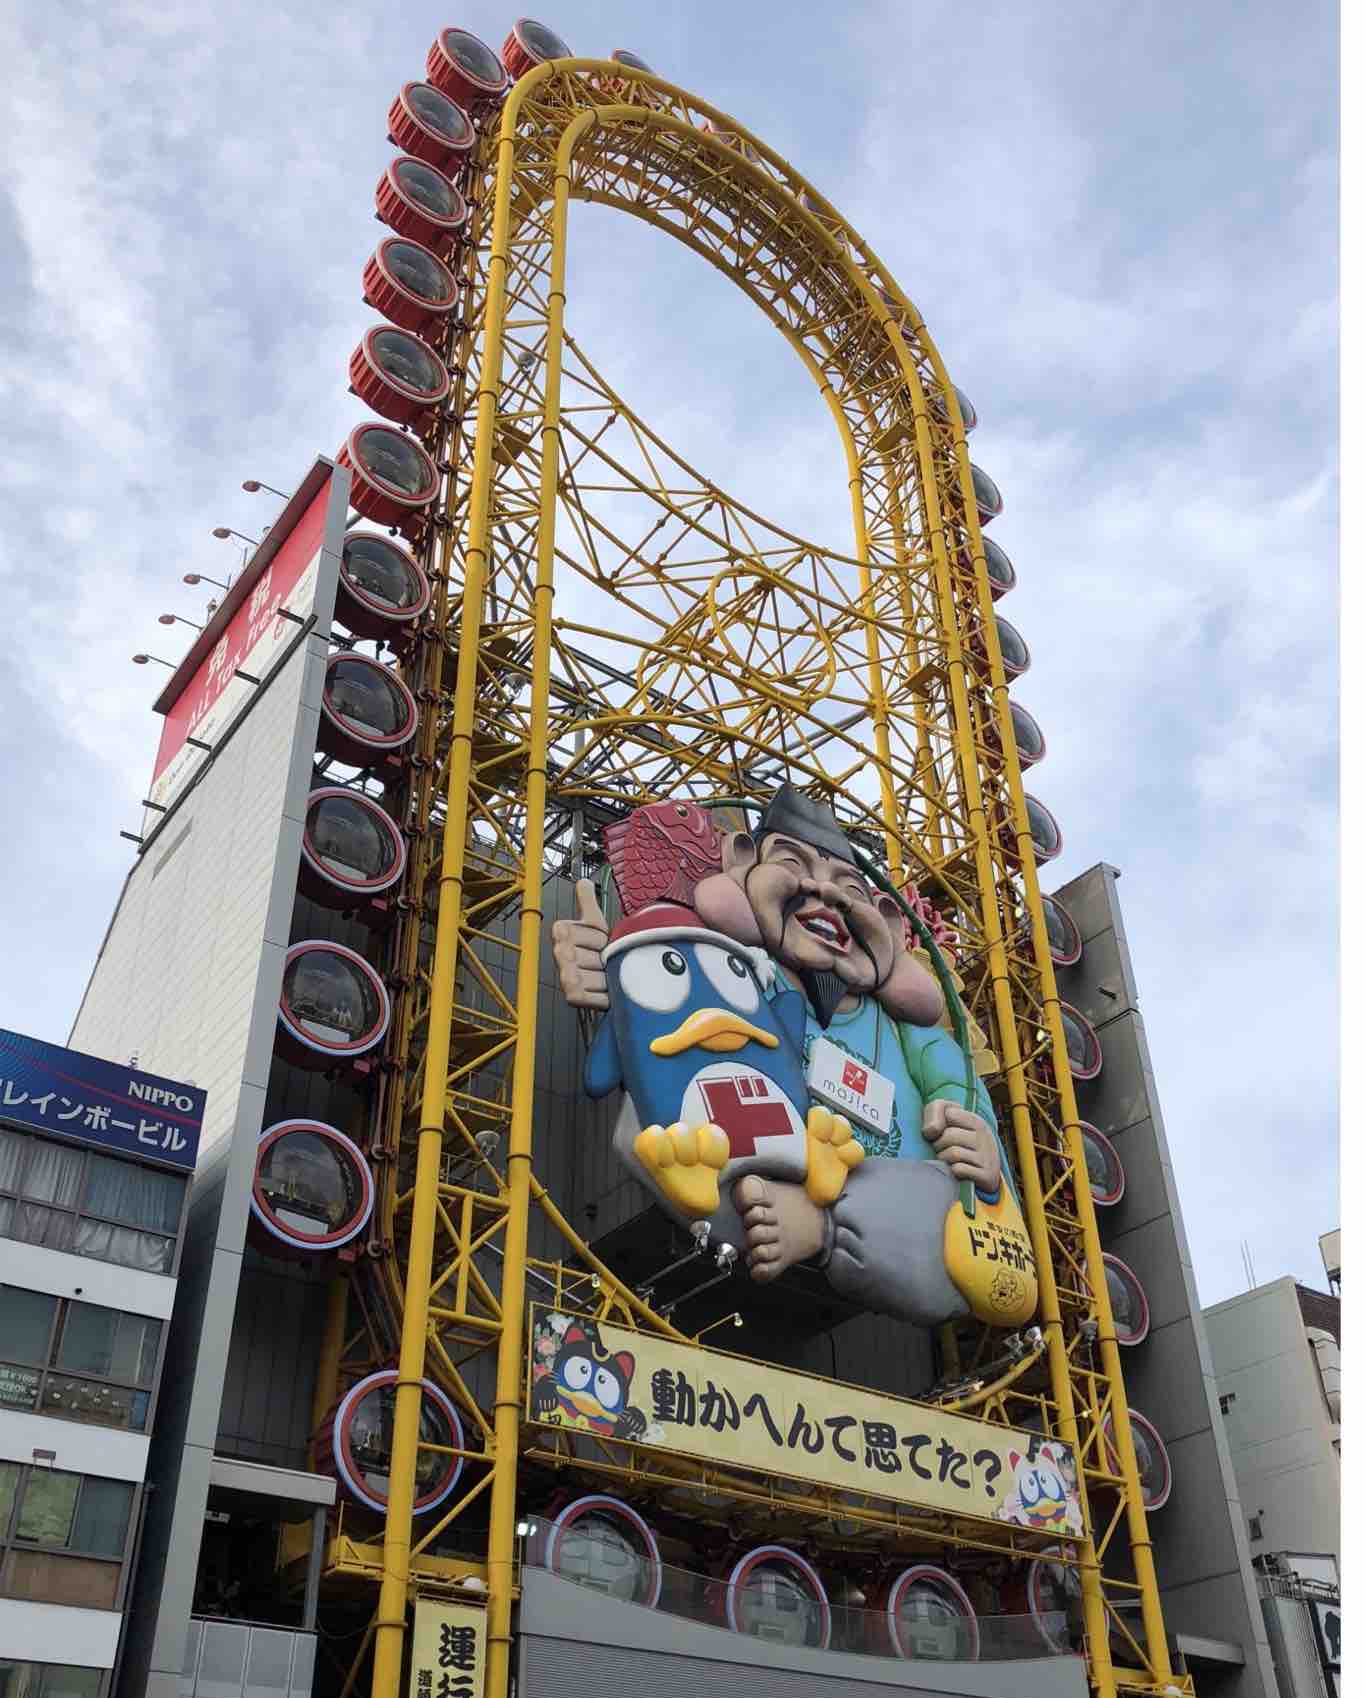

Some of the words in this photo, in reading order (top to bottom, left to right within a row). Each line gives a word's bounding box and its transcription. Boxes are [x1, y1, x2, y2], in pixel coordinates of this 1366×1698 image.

[0, 1078, 188, 1152] レインボービル
[128, 1080, 194, 1113] NIPPO
[823, 1078, 880, 1121] majica
[649, 1367, 1002, 1497] 動かへんて思てた?
